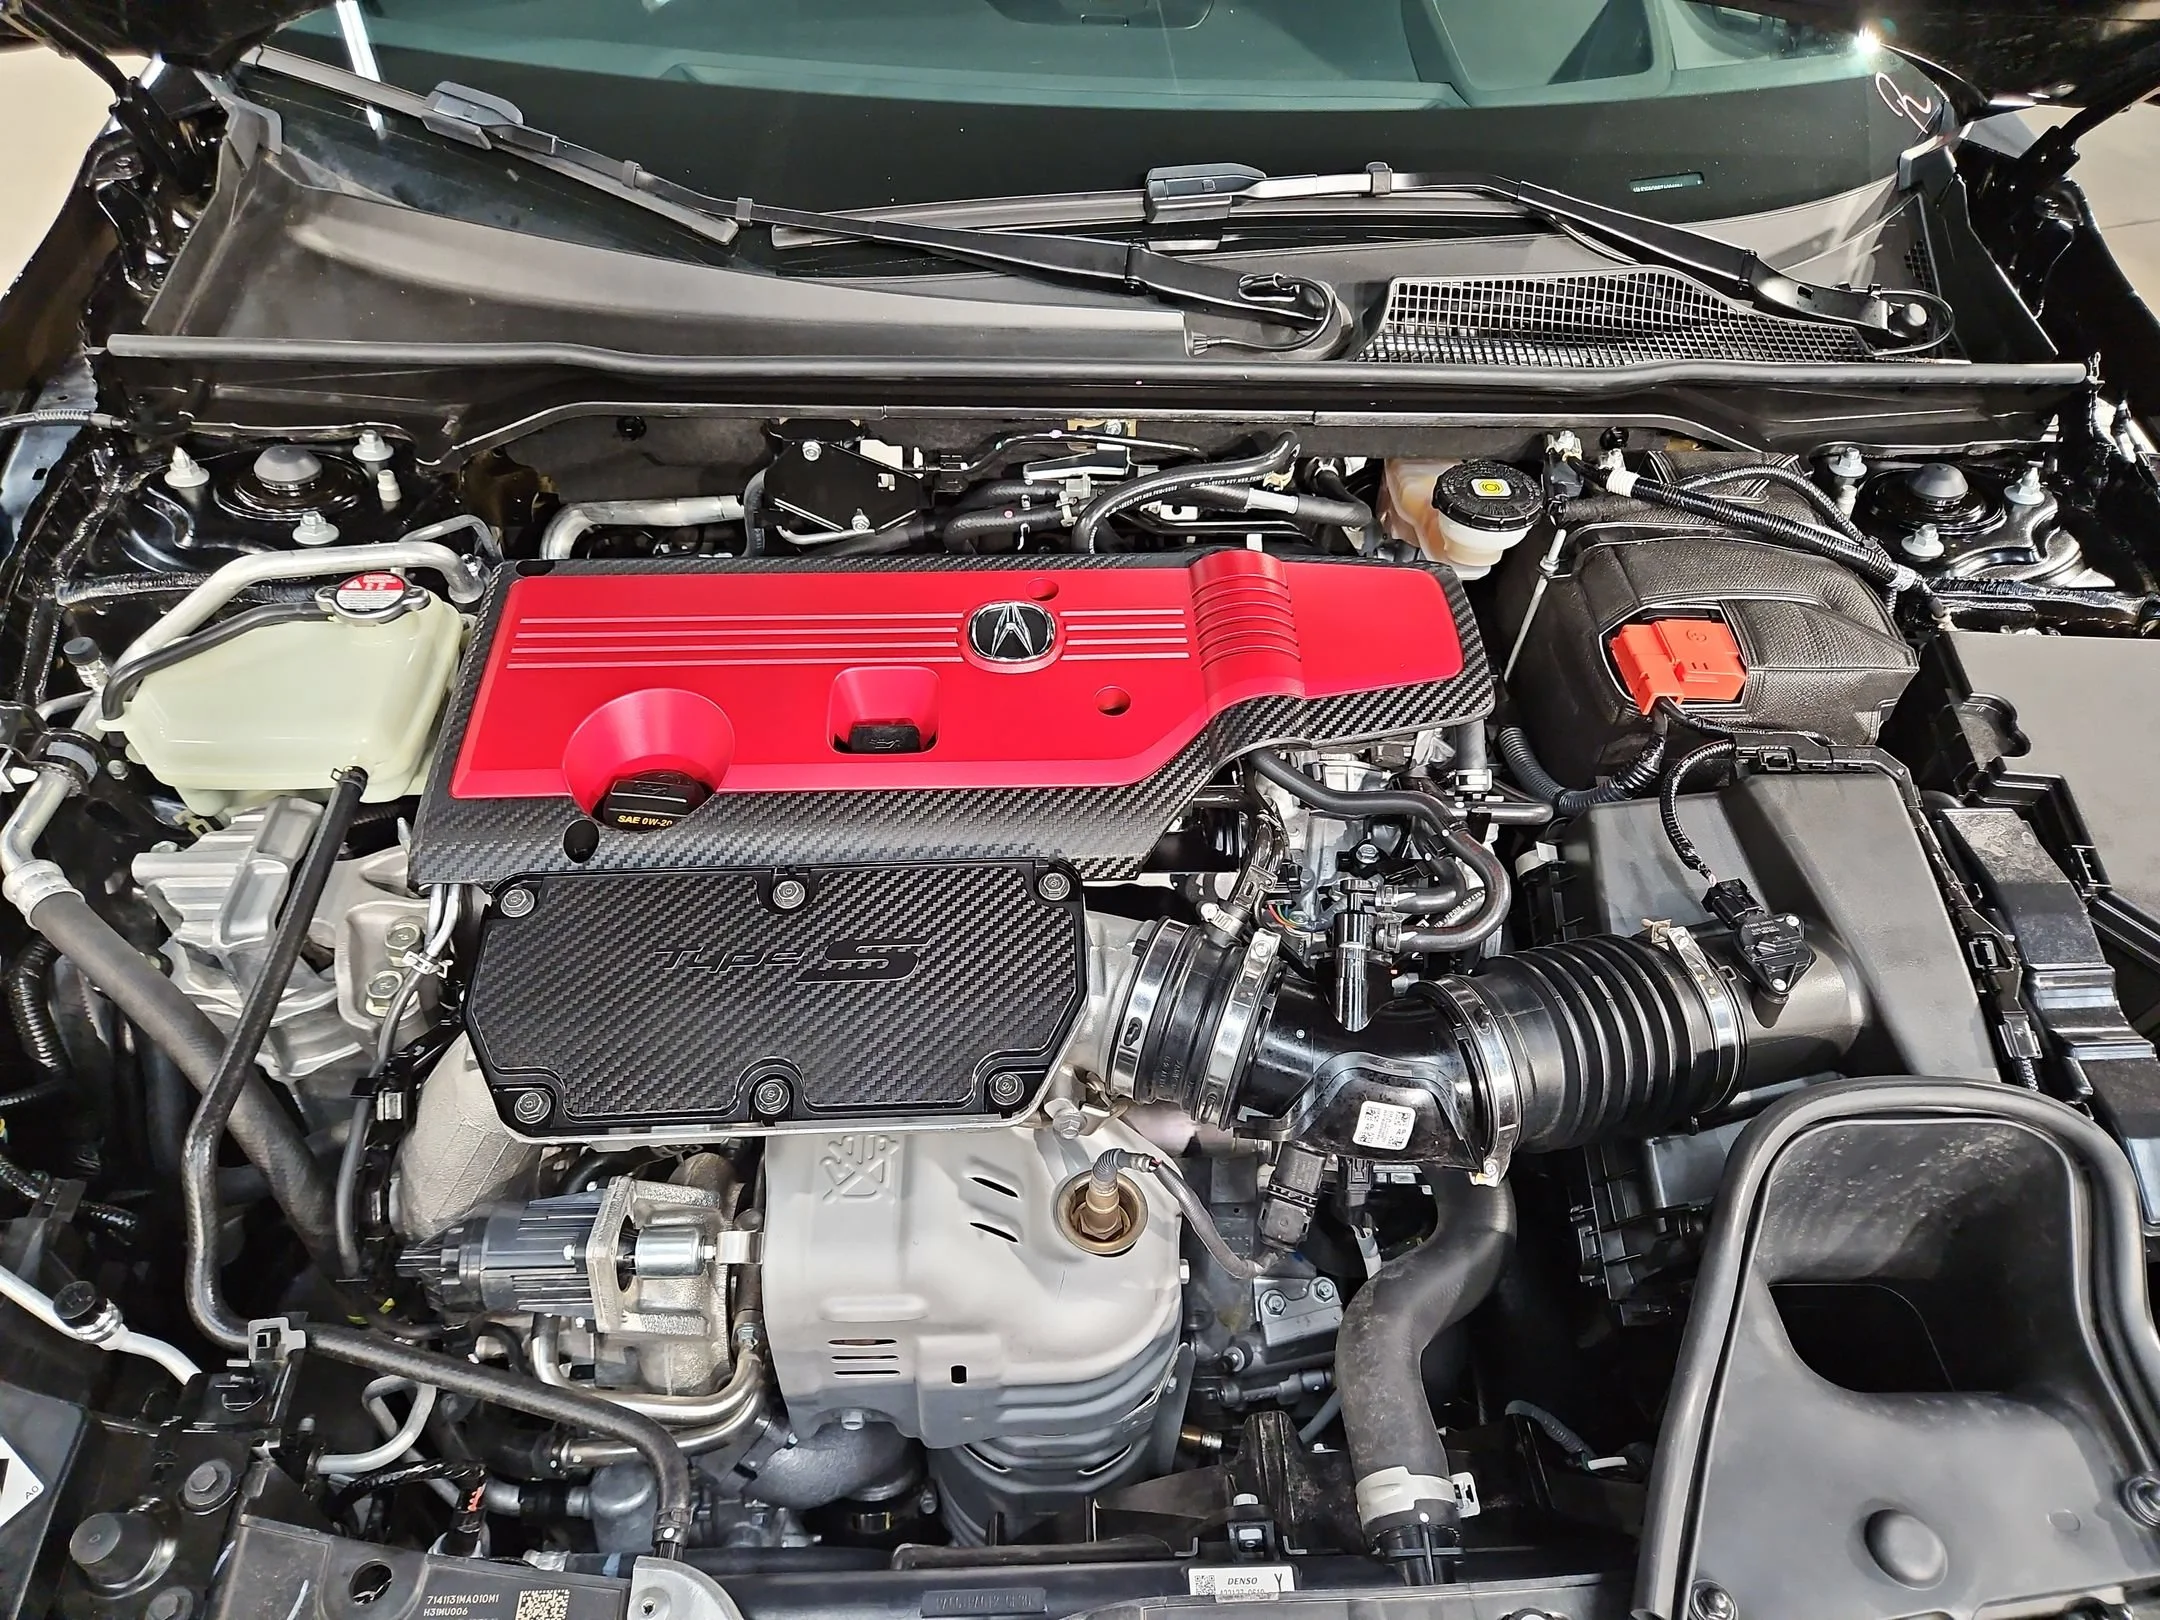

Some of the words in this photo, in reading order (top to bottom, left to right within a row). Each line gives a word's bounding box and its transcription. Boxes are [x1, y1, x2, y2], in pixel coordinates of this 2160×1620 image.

[617, 815, 641, 824] SAE
[642, 818, 673, 827] 0W-20
[795, 937, 932, 984] S
[1227, 1577, 1258, 1585] DENSO
